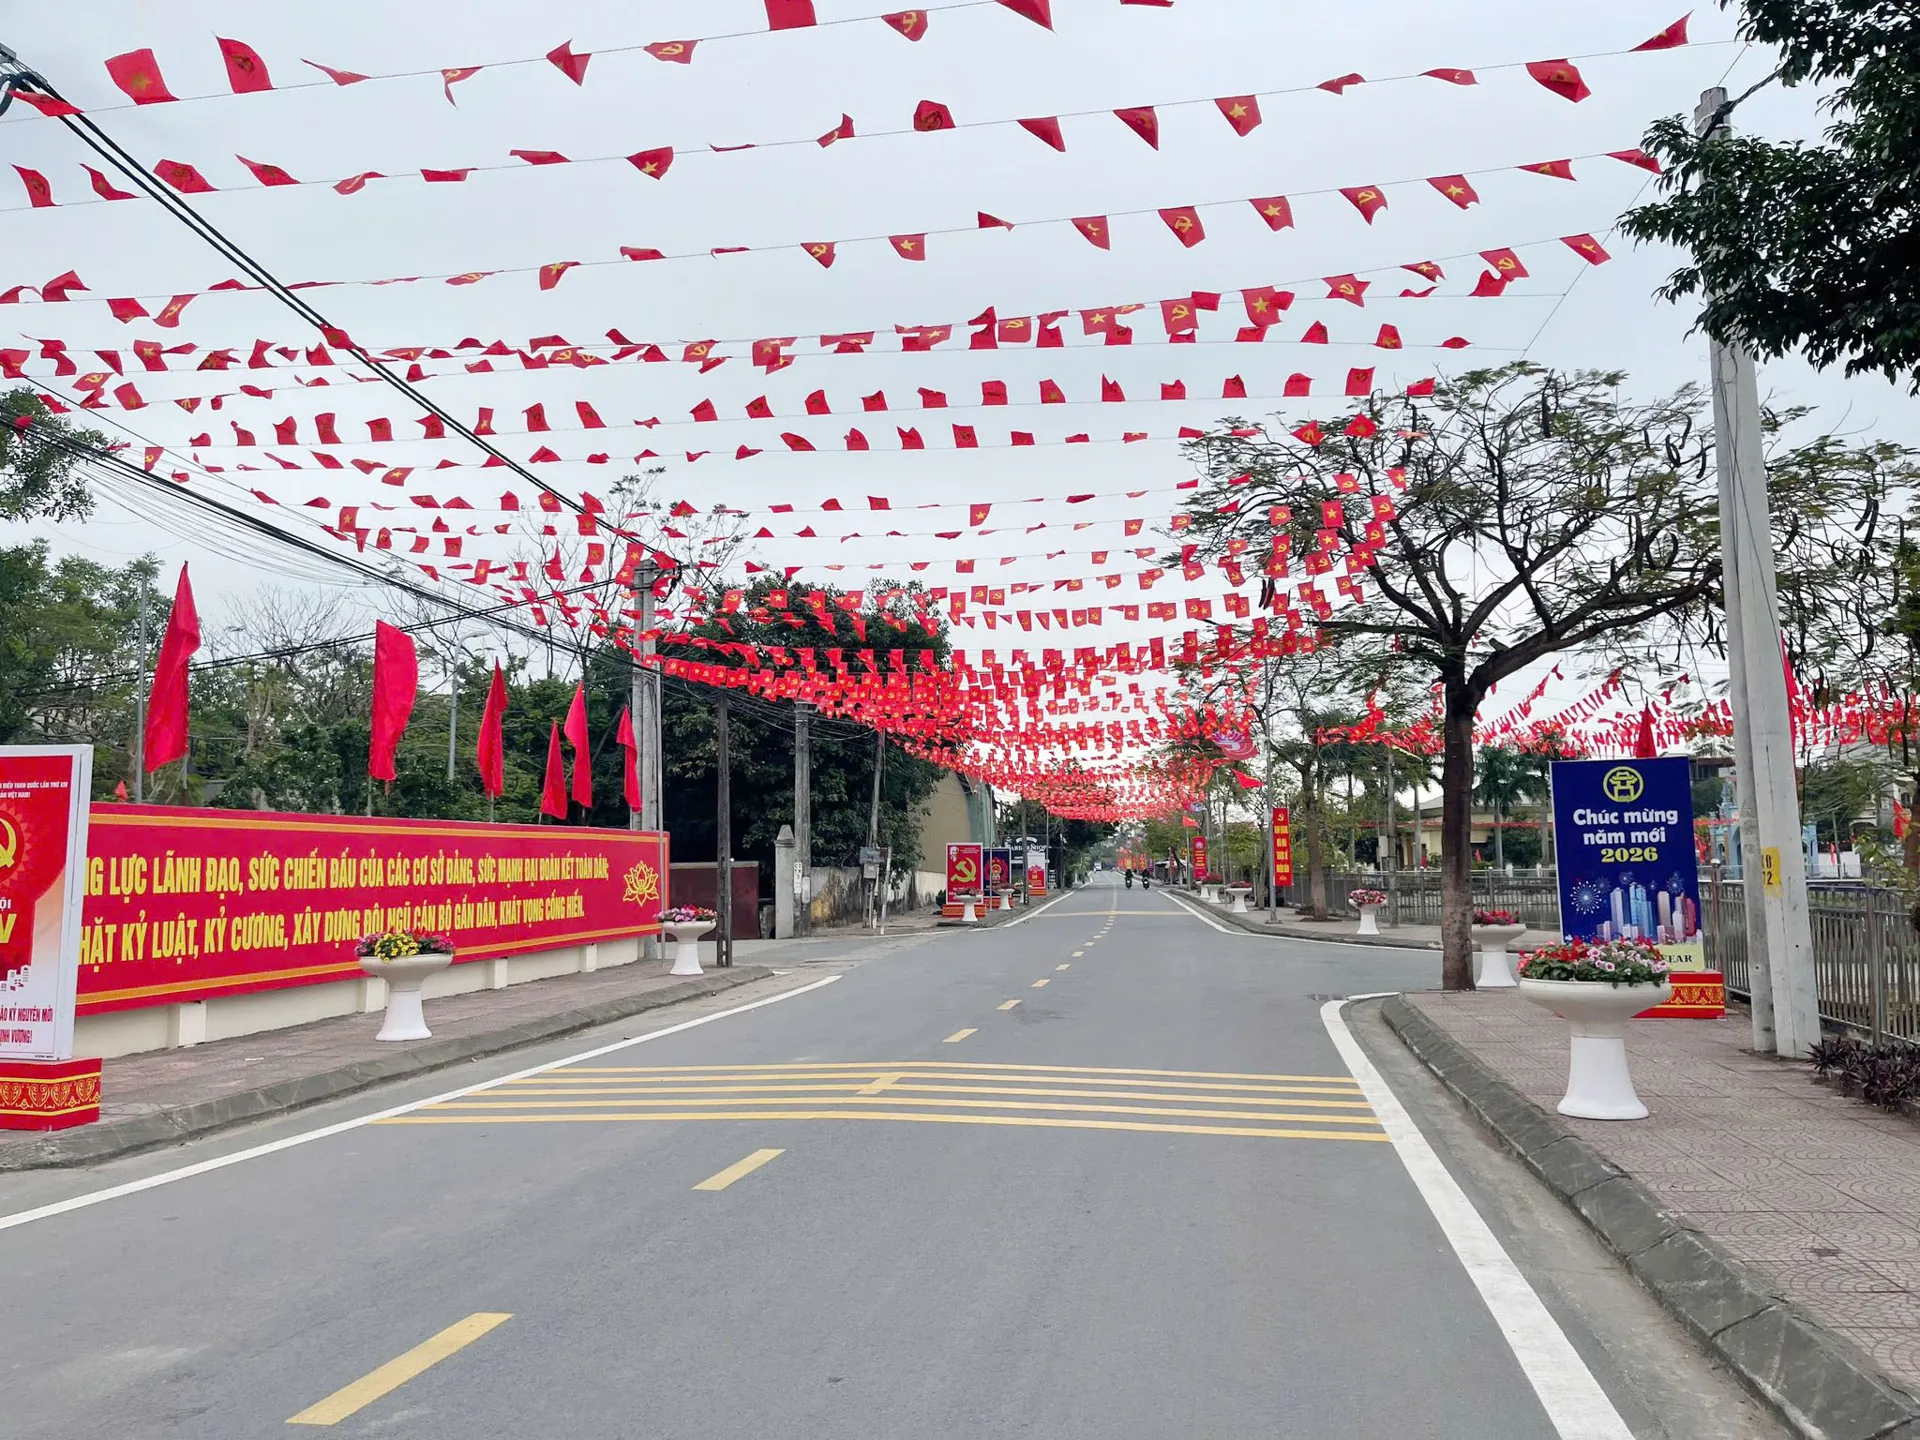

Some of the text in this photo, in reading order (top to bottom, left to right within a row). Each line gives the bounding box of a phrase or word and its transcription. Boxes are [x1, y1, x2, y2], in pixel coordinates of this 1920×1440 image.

[1573, 807, 1678, 826] Chúc mừng
[1583, 826, 1666, 845] năm mới
[1601, 846, 1659, 863] 2026
[109, 853, 148, 904] LỰC
[152, 850, 200, 894] LÃNH
[205, 857, 243, 900] ĐẠO,
[248, 850, 280, 891] SỨC
[283, 847, 327, 890] CHIẾN
[330, 847, 357, 889] ĐẤU
[360, 848, 384, 888] CỦA
[387, 852, 410, 887] CÁC
[413, 855, 428, 886] CƠ
[430, 849, 445, 886] SỞ
[446, 849, 476, 887] ĐẢNG,
[478, 852, 496, 884] SỨC
[498, 858, 523, 888] MẠNH
[524, 858, 538, 887] ĐẠI
[540, 852, 560, 881] ĐOÀN
[561, 850, 575, 880] KẾT
[575, 852, 593, 879] TOÀN
[121, 909, 148, 961] KỶ
[152, 912, 199, 965] LUẬT,
[204, 906, 227, 954] KỶ
[231, 912, 288, 951] CƯƠNG,
[292, 906, 321, 945] XÂY
[324, 907, 360, 948] DỰNG
[387, 901, 411, 934] NGŨ
[414, 900, 436, 932] CÁN
[438, 898, 452, 937] BỘ
[476, 897, 497, 929] DÂN,
[500, 895, 521, 926] KHÁT
[523, 898, 544, 928] VỌNG
[545, 889, 565, 921] CỐNG
[566, 888, 585, 918] HIẾN.
[9, 1002, 17, 1021] KỶ
[18, 1005, 40, 1022] NGUYÊN
[41, 1004, 53, 1022] MỚI
[11, 1028, 33, 1046] VƯỢNG!
